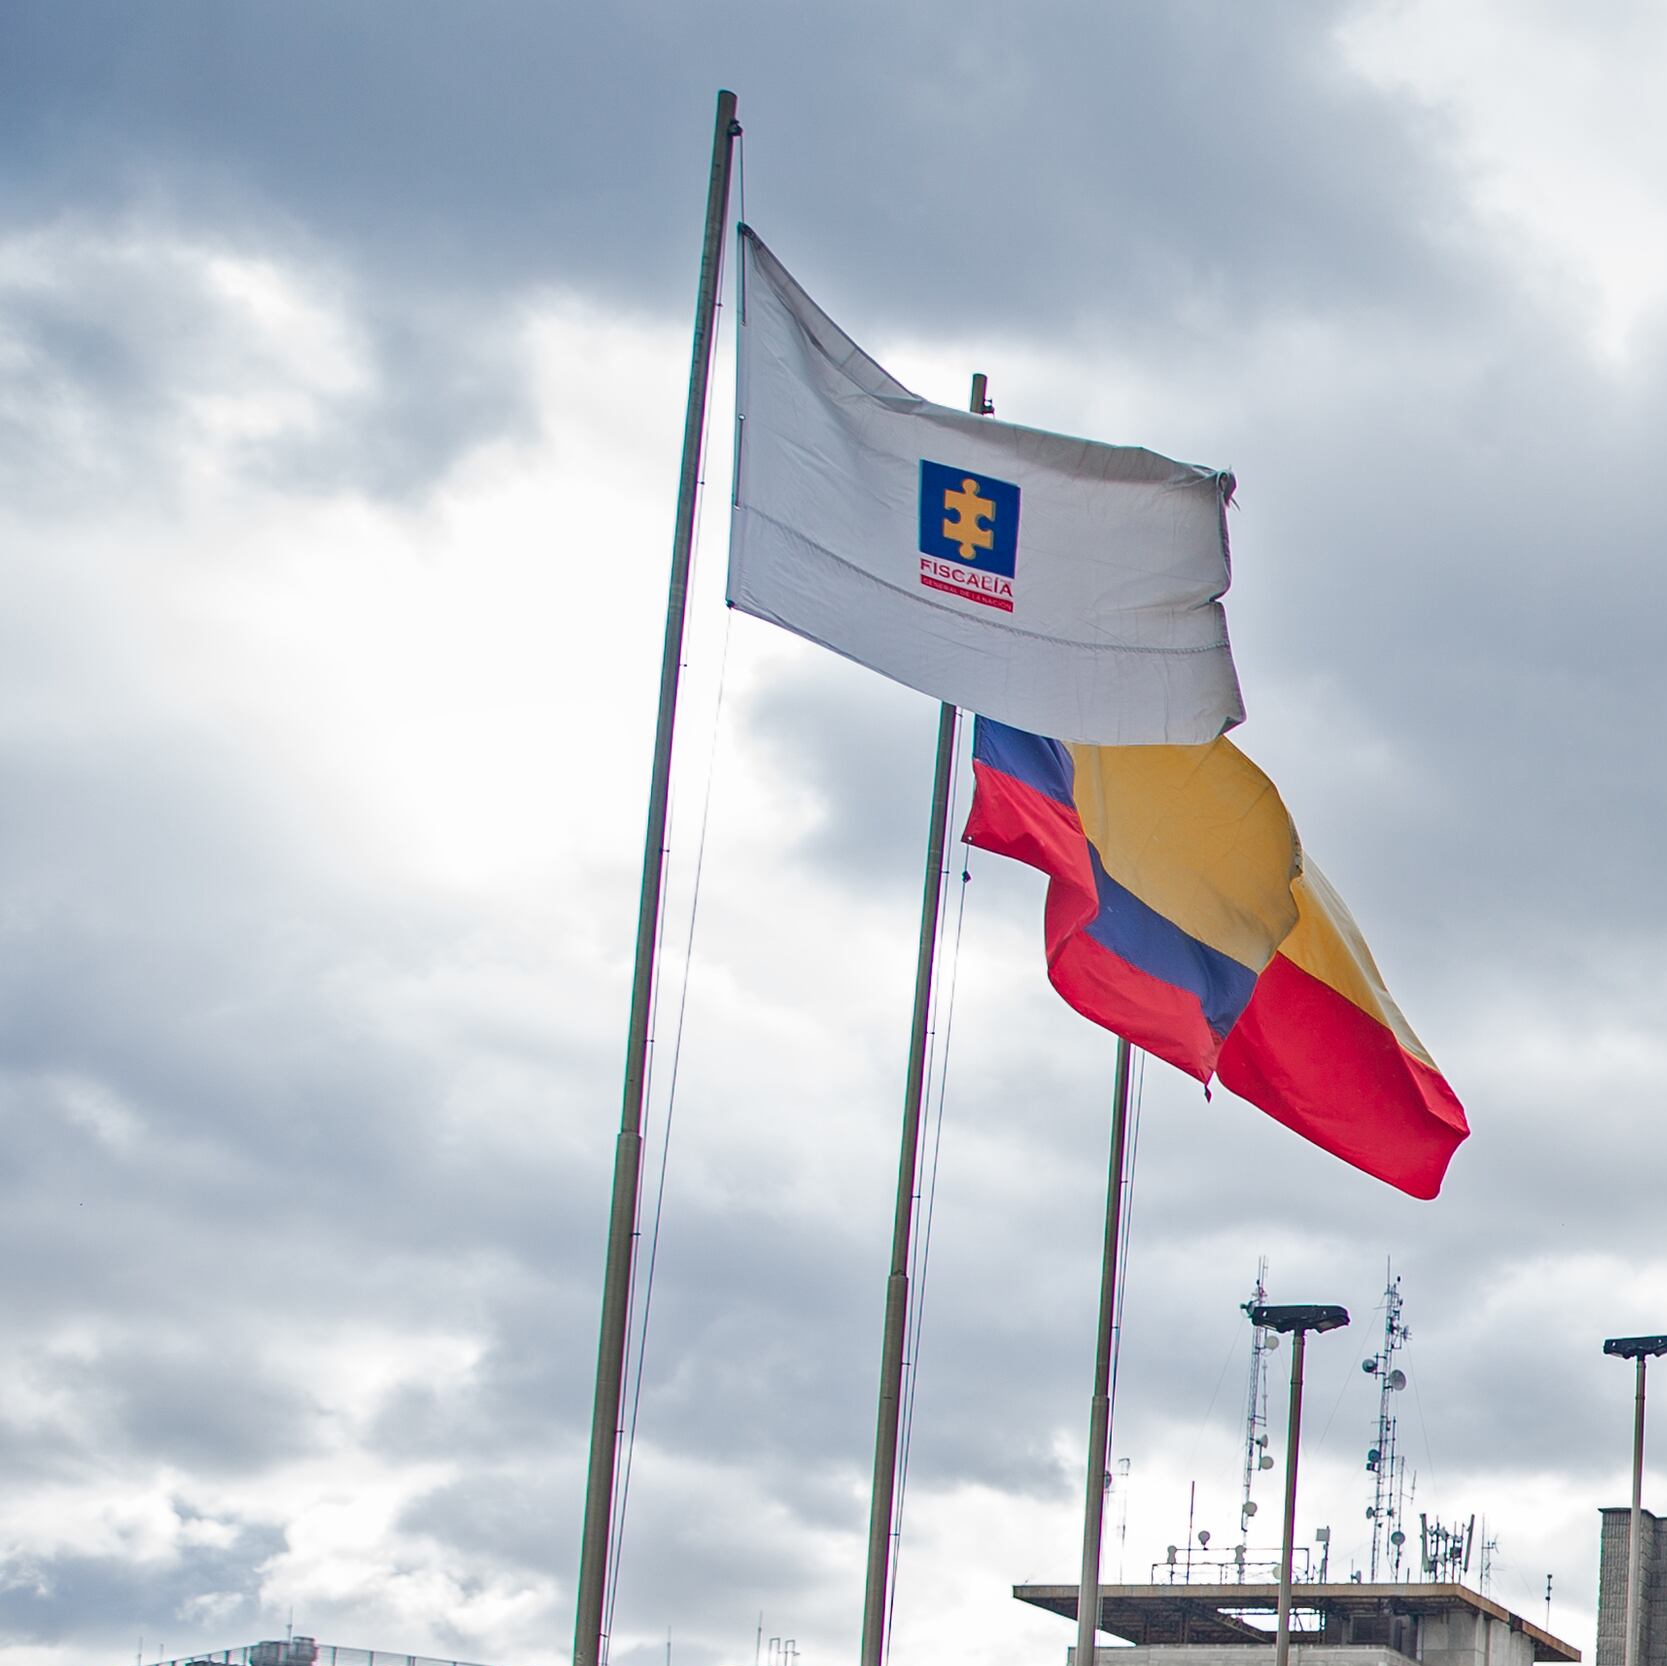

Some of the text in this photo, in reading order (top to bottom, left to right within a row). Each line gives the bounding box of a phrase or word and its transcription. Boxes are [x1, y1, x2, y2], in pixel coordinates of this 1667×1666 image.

[923, 577, 958, 594] GENERAL
[960, 589, 969, 598] DE
[972, 593, 981, 601] LA
